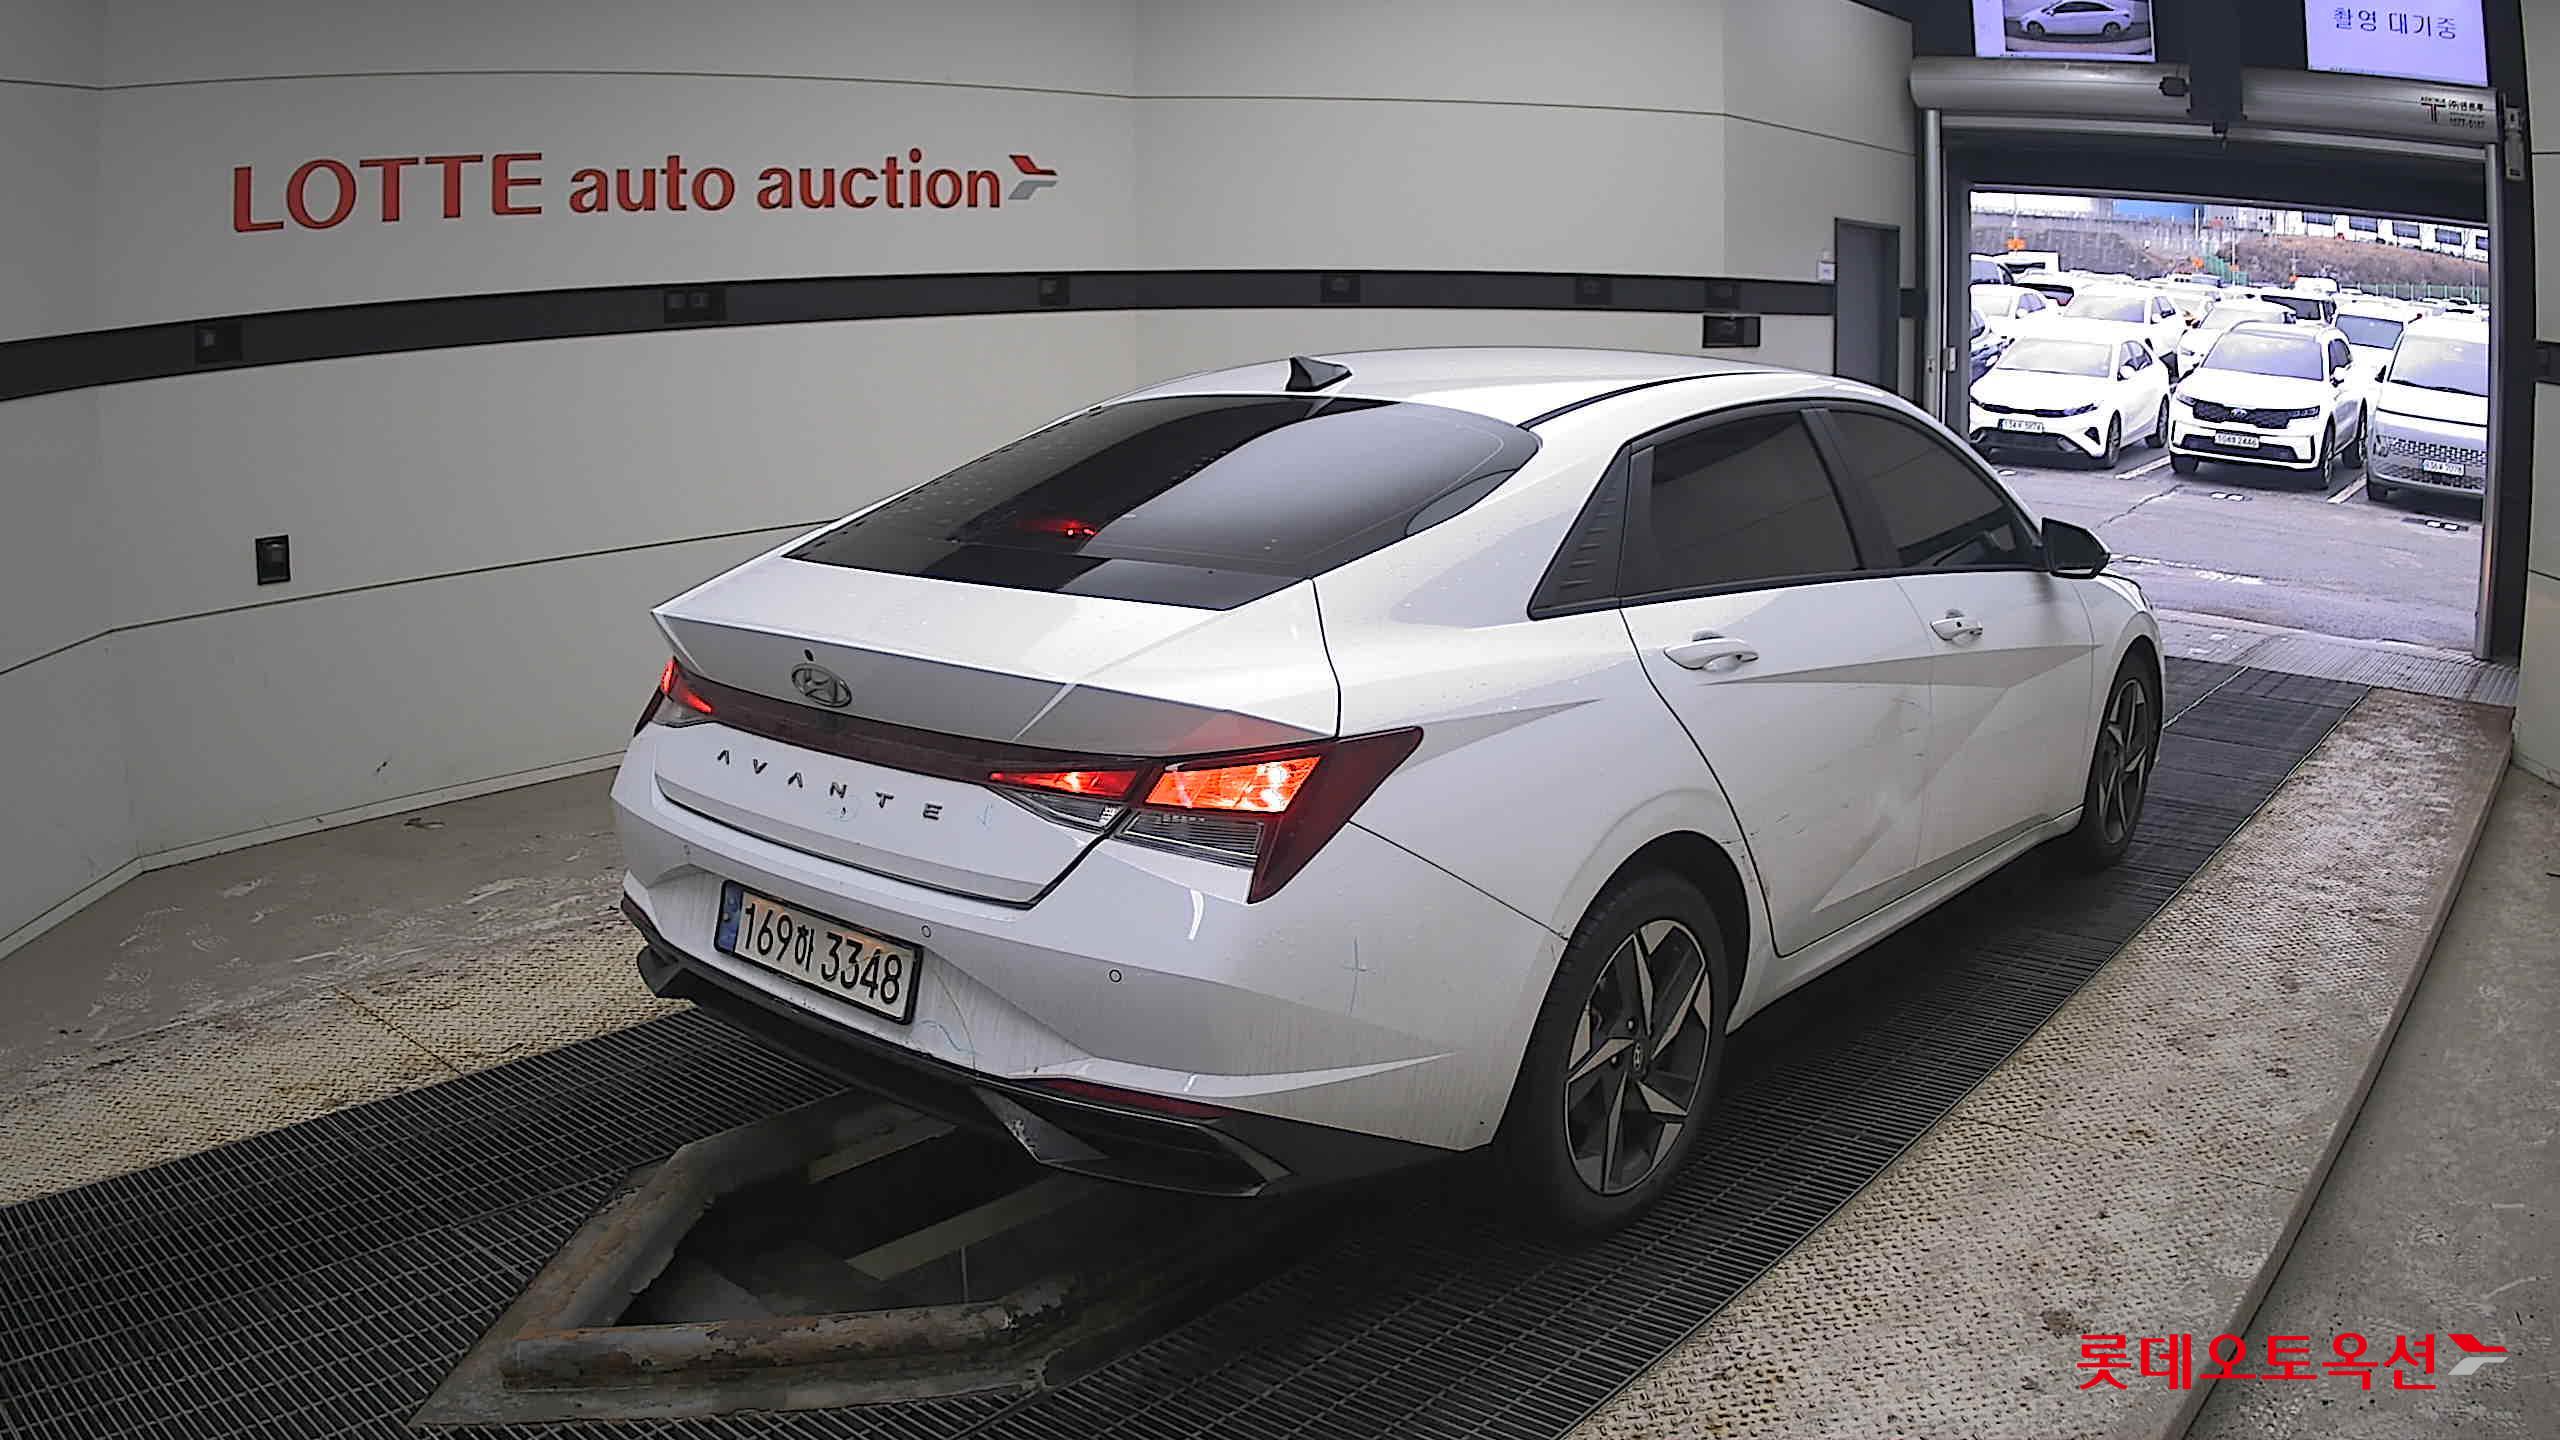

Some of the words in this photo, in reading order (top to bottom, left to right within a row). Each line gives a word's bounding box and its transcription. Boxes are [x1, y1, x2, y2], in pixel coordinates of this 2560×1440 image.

[2334, 7, 2377, 32] 촬영
[2388, 12, 2457, 40] 대기중
[233, 152, 543, 232] LOTTE
[569, 155, 736, 213] auto
[757, 148, 1001, 209] auction
[717, 750, 943, 820] AVANTE
[744, 902, 814, 972] 169하
[821, 931, 903, 1005] 3348
